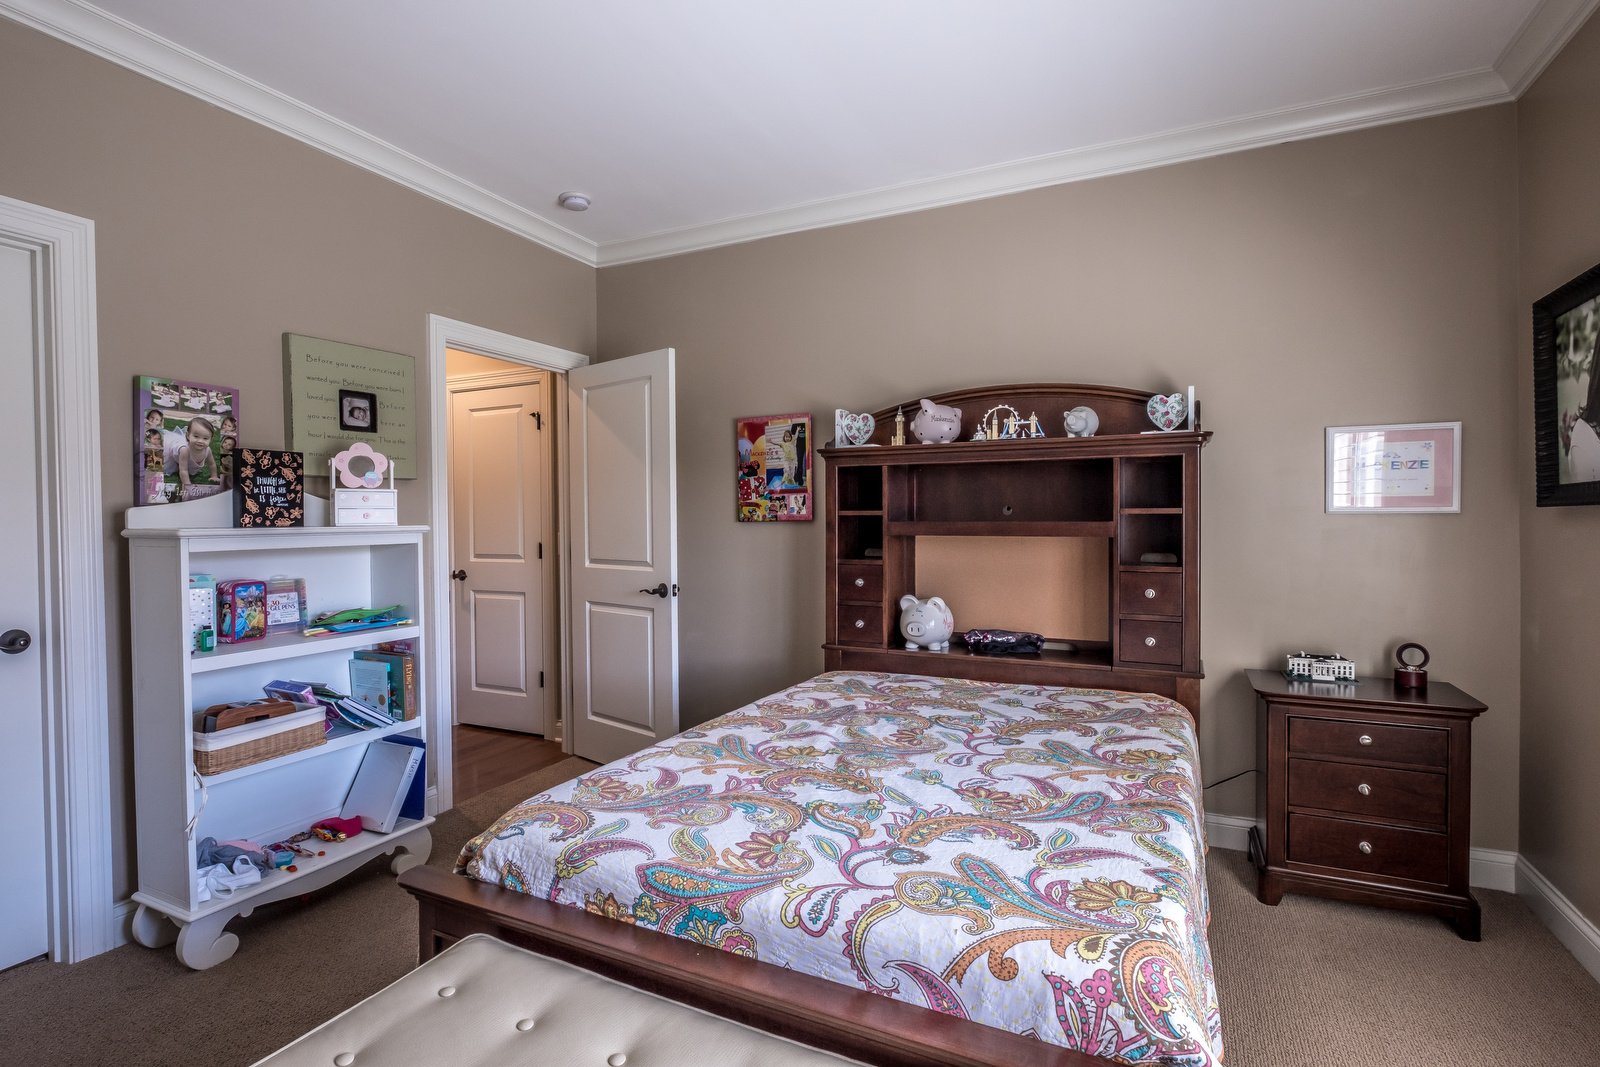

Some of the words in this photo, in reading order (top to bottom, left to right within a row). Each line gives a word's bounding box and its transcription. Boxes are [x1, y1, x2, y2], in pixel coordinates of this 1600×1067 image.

[305, 353, 333, 365] Before
[368, 367, 401, 377] conceived
[305, 375, 328, 383] wanted
[342, 378, 363, 388] Before
[306, 392, 324, 401] loved
[379, 400, 406, 411] Before
[307, 431, 322, 439] hour
[281, 603, 296, 611] PENS
